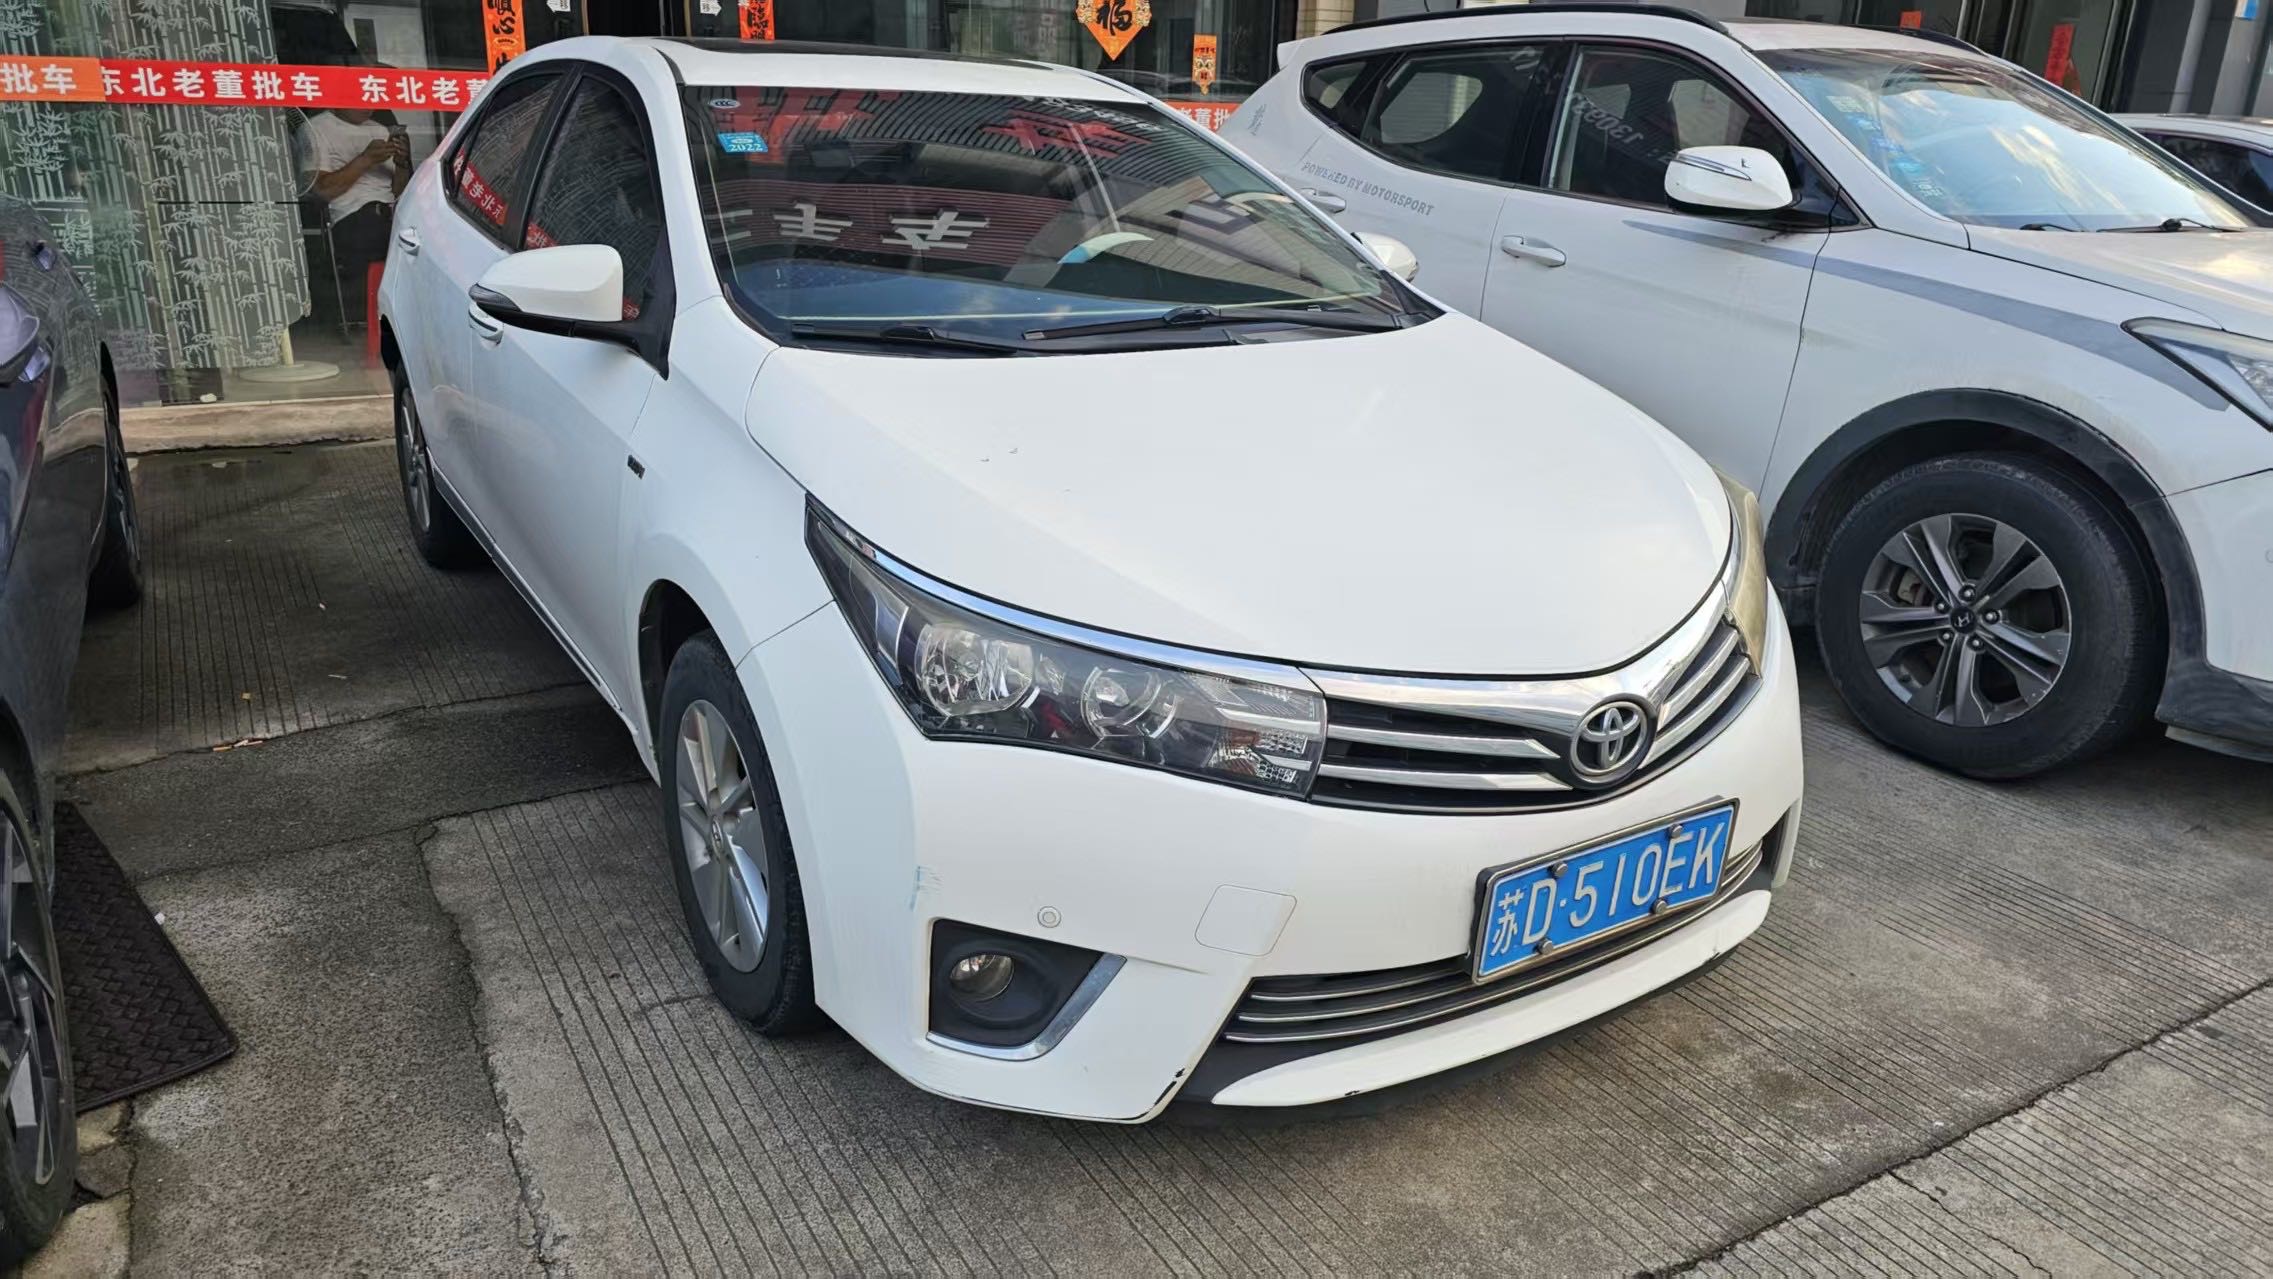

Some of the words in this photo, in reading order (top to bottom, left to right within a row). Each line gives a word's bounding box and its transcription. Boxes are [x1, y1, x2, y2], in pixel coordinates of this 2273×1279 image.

[1096, 0, 1132, 36] 福
[102, 66, 323, 101] 东北老董批车
[730, 143, 762, 151] 2022
[1301, 161, 1347, 184] POWERED
[1363, 182, 1435, 216] MOTORSPORT
[1491, 822, 1724, 957] 苏D·510EK
